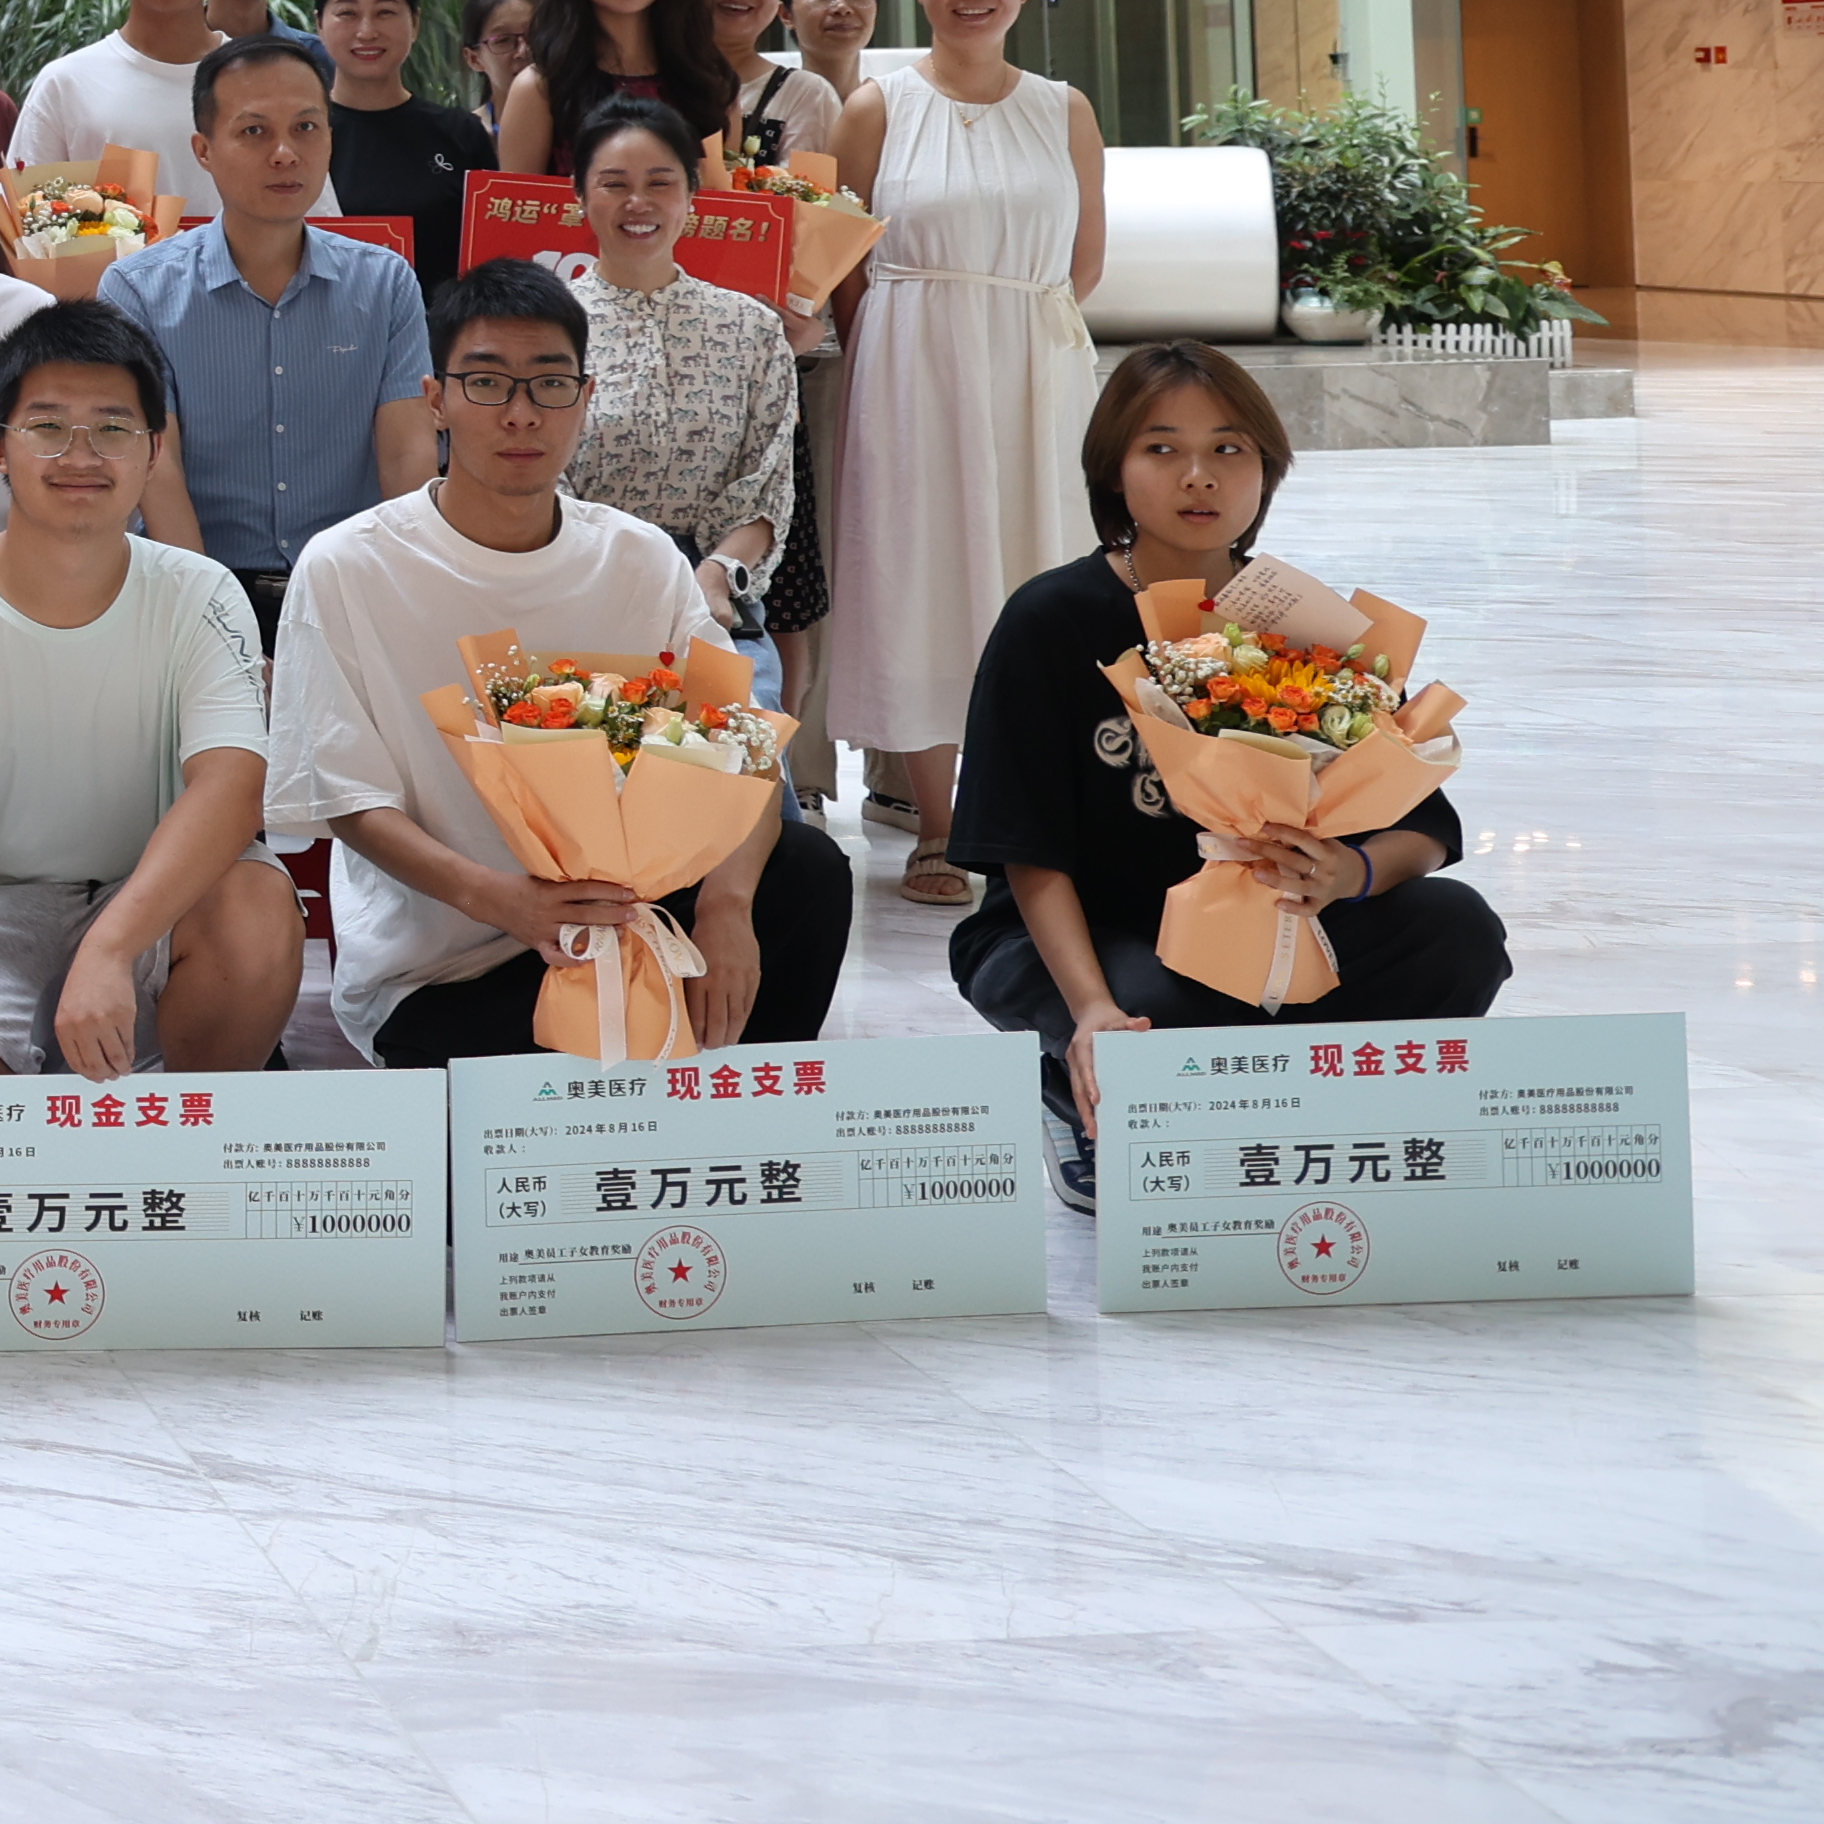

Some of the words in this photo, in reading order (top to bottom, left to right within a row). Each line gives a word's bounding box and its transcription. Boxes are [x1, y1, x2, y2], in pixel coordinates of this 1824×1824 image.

[485, 196, 584, 228] 鸿运“罩
[680, 213, 771, 242] 榜题名!
[1209, 1053, 1291, 1076] 奥美医疗
[1308, 1038, 1470, 1078] 现金支票
[566, 1076, 648, 1100] 奥美医疗
[665, 1059, 827, 1101] 现金支票
[1516, 1084, 1634, 1099] 奥美医疗用品股份有限公司
[44, 1091, 214, 1128] 现金支票
[872, 1103, 989, 1120] 奥美医疗用品股份有限公司
[1207, 1096, 1301, 1111] 2024年8月16日
[564, 1119, 658, 1136] 2024年8月16日
[262, 1140, 386, 1153] 奥美医疗用品股份有限公司
[1139, 1148, 1191, 1168] 人民币
[1237, 1136, 1446, 1187] 壹万元整
[495, 1174, 547, 1194] 人民币
[594, 1158, 803, 1212] 壹万元整
[1141, 1173, 1190, 1193] (大写)
[497, 1198, 546, 1219] (大写)
